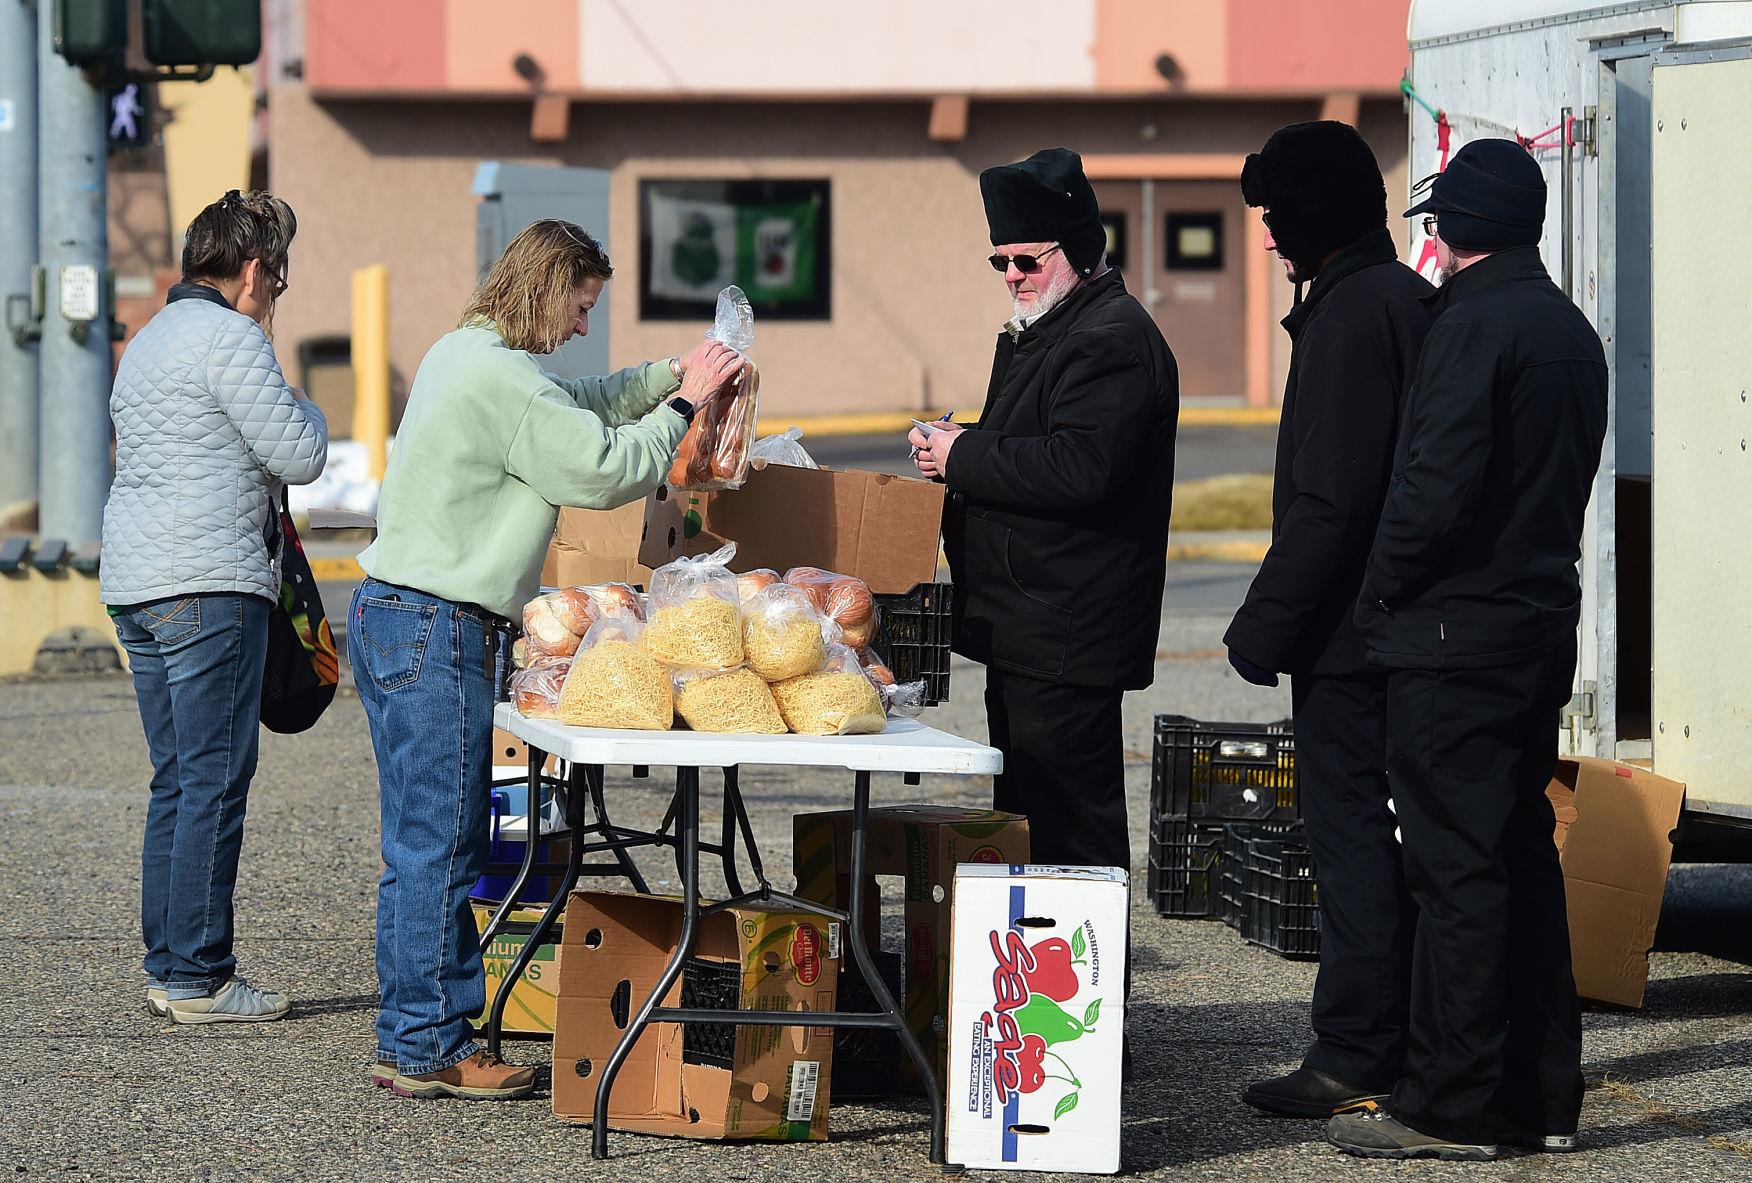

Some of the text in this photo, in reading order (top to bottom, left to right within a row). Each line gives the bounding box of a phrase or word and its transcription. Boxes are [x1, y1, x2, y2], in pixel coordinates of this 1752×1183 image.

[487, 937, 525, 956] ium
[803, 928, 813, 982] Del Monte
[1084, 919, 1100, 987] WASHINGTON
[988, 930, 1034, 1104] Sage
[969, 1023, 982, 1111] EATING EXPERIENCE
[983, 1039, 992, 1118] AN EXCEPTIONAL
